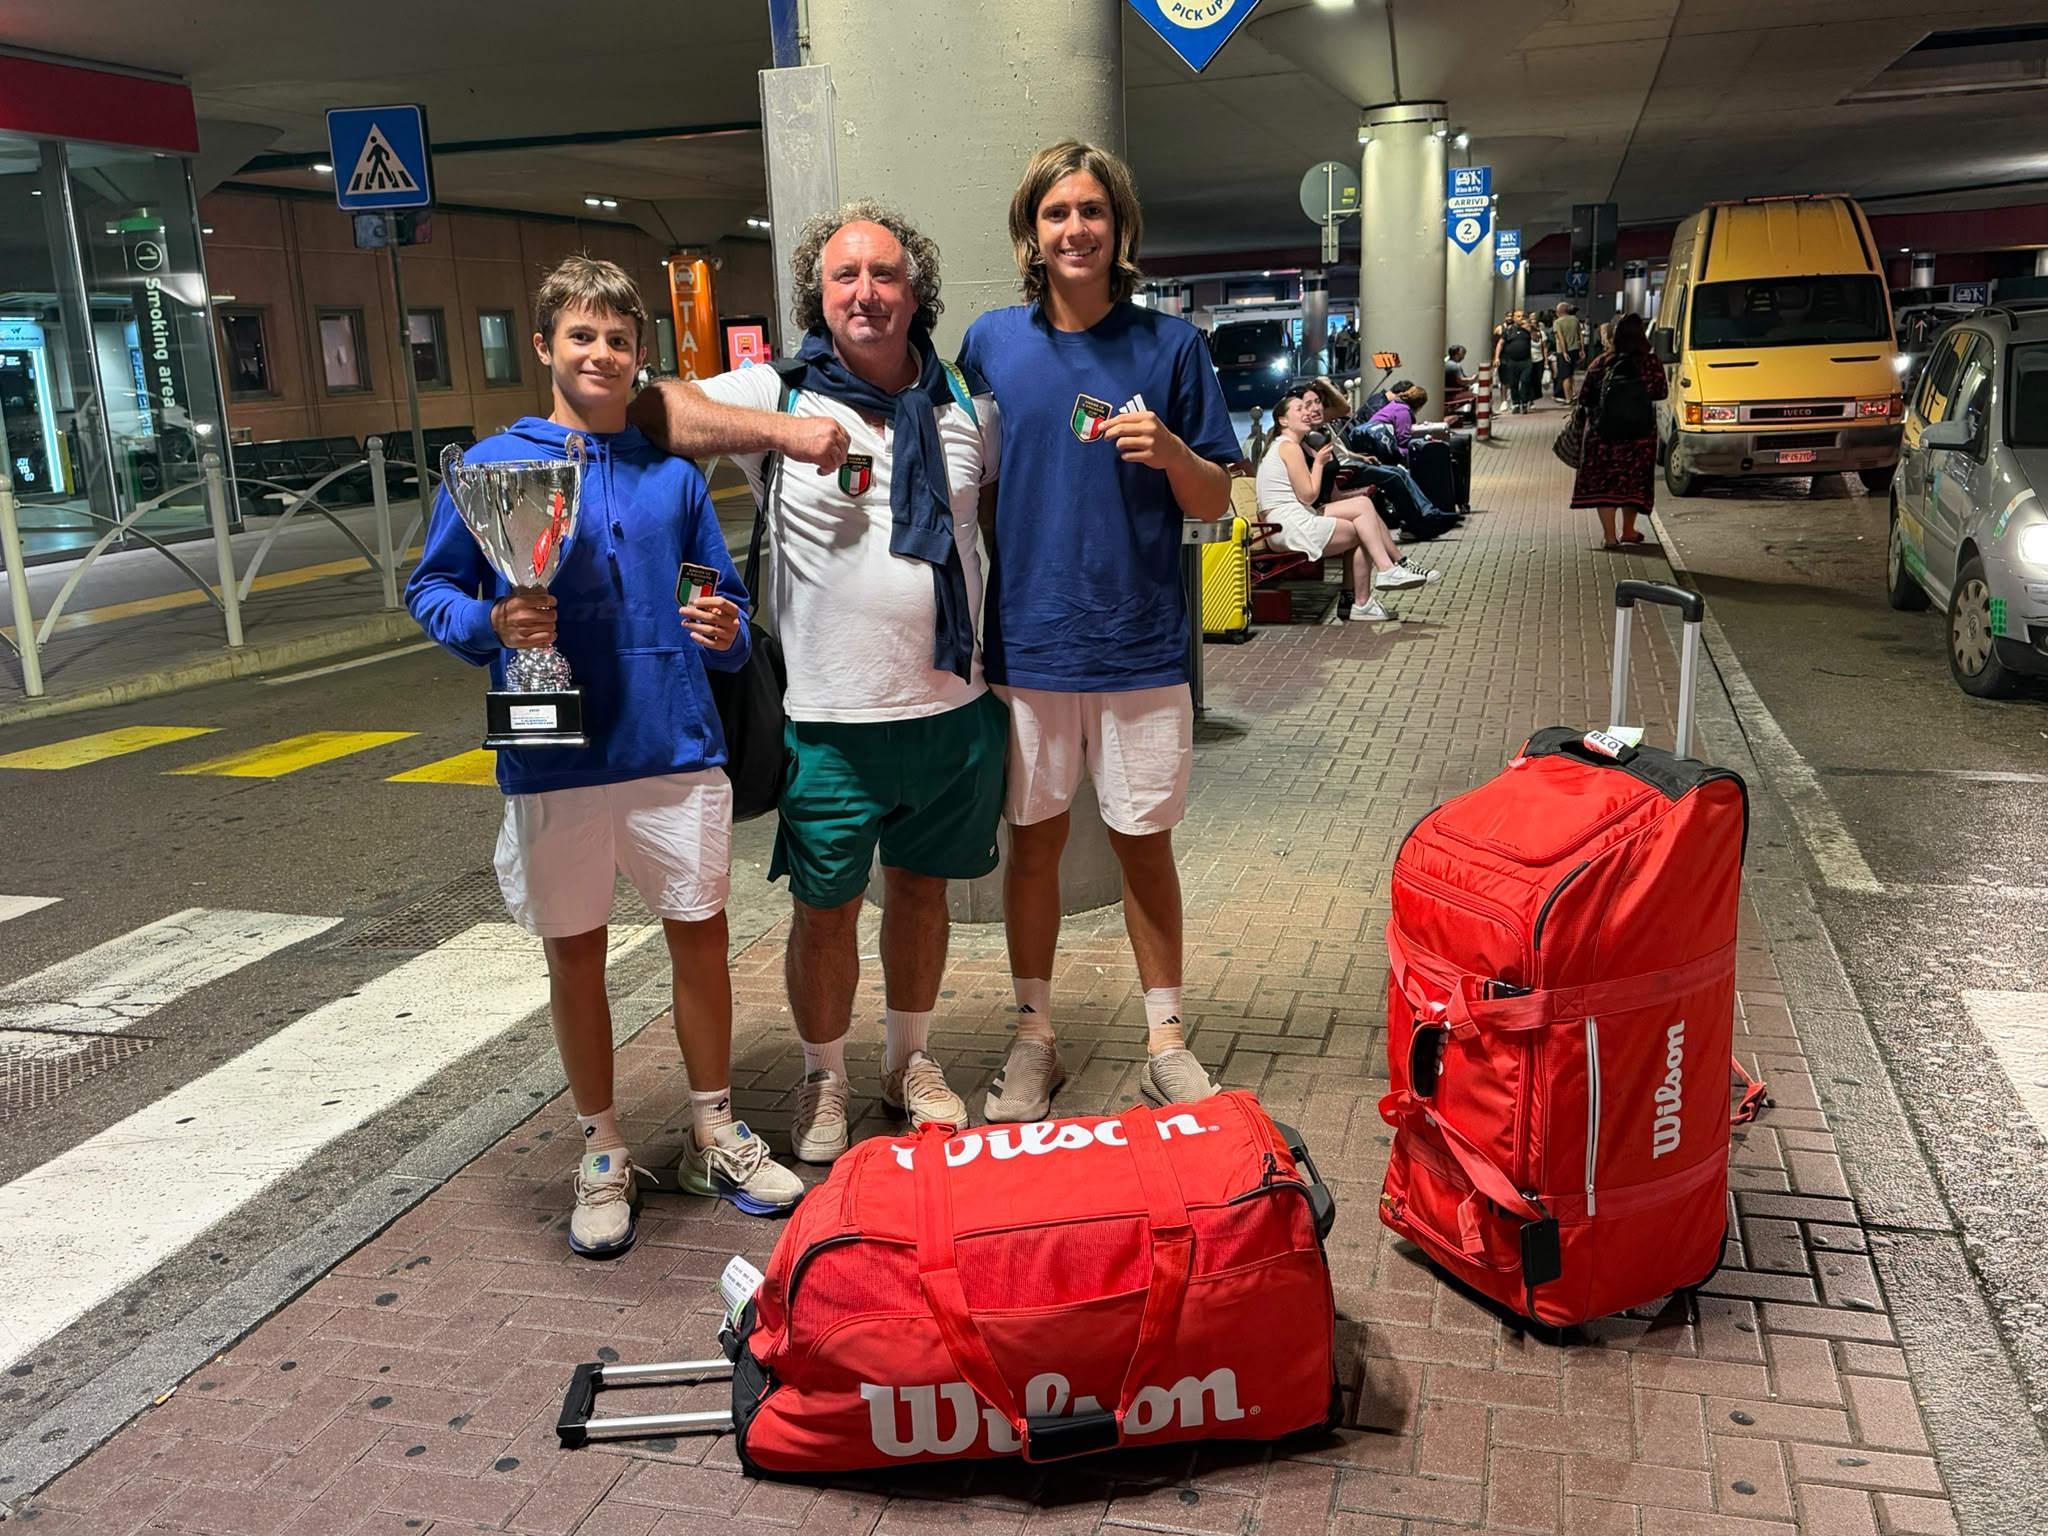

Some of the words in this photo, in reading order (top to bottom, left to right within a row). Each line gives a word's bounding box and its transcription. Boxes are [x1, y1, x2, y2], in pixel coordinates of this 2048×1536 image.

[1171, 2, 1203, 21] PICK
[1206, 0, 1223, 17] UP
[1454, 198, 1484, 207] ARRIVI
[1463, 223, 1472, 235] 2
[146, 276, 169, 361] Smoking
[159, 367, 176, 408] area
[678, 301, 699, 381] TAX
[1783, 408, 1812, 417] IVECO
[1590, 732, 1619, 751] BLQ
[1653, 1020, 1685, 1159] Wilson
